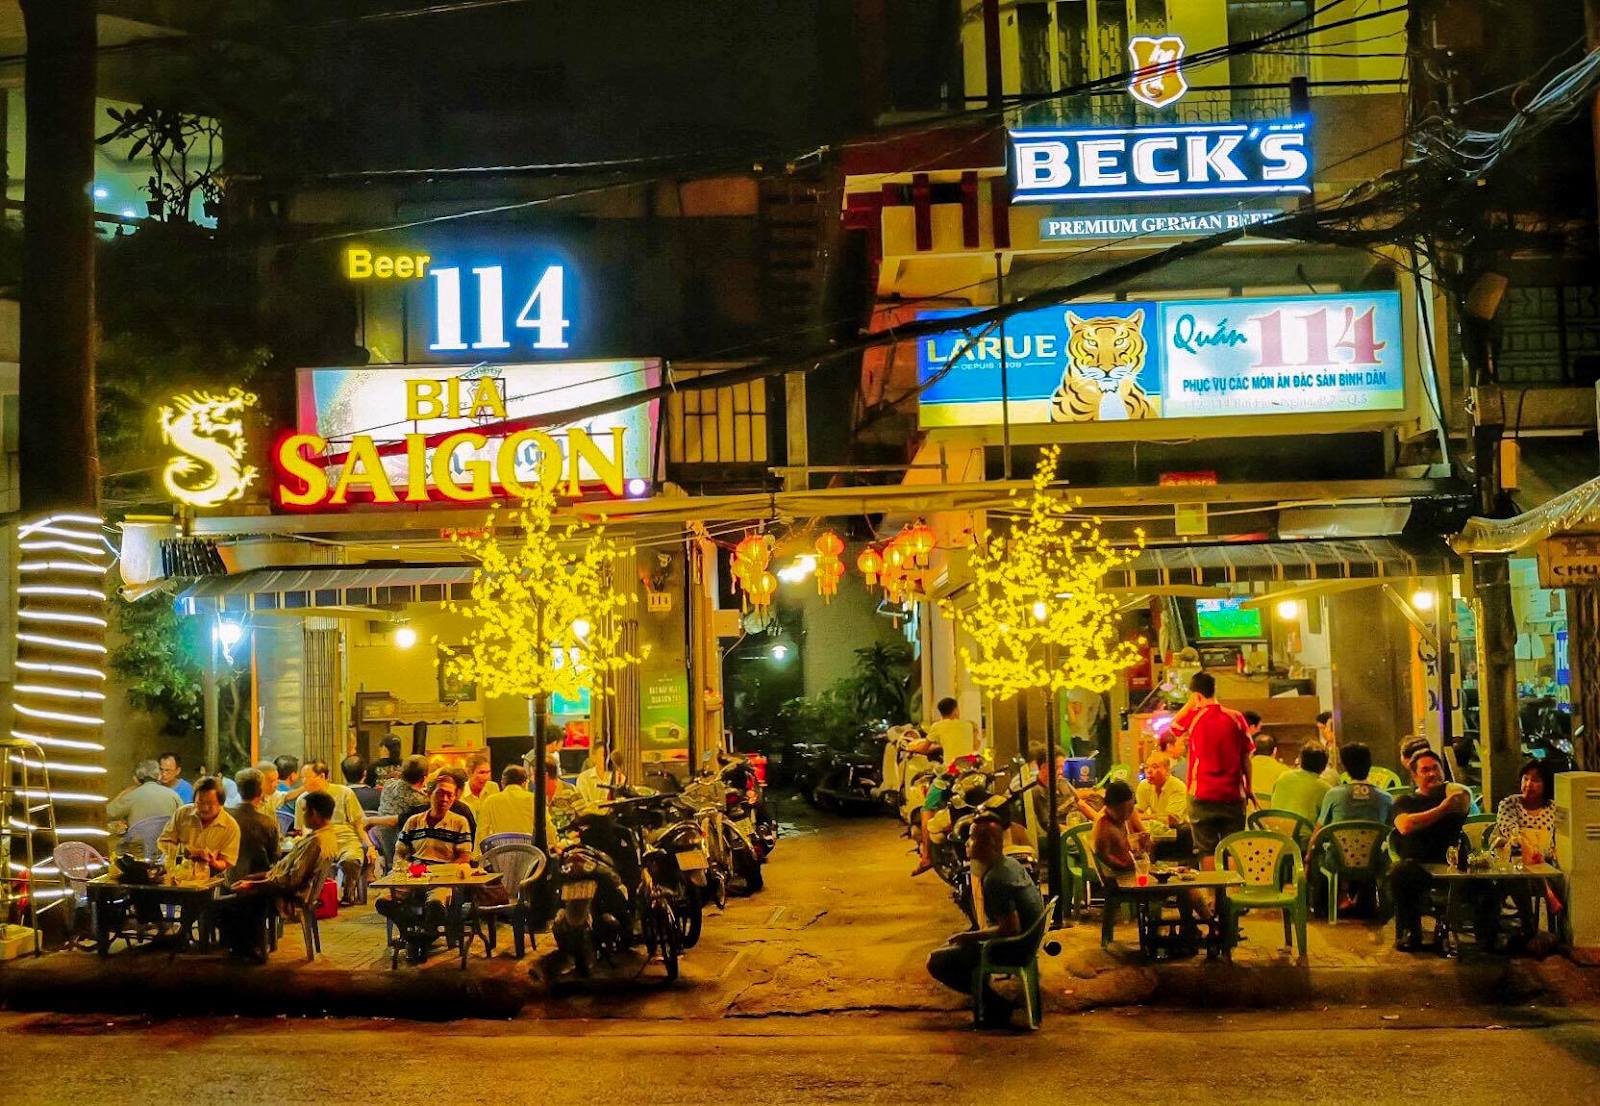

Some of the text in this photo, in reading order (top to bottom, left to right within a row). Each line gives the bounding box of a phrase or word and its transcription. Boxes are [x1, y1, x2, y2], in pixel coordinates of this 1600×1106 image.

[1014, 126, 1308, 190] BECK'S
[1049, 217, 1139, 236] PREMIUM
[1141, 214, 1223, 234] GERMAN
[347, 248, 570, 351] Beer 114
[926, 334, 1058, 363] LARUE
[1174, 305, 1386, 368] Quán 114
[404, 375, 508, 420] BIA
[279, 426, 628, 506] SAIGON
